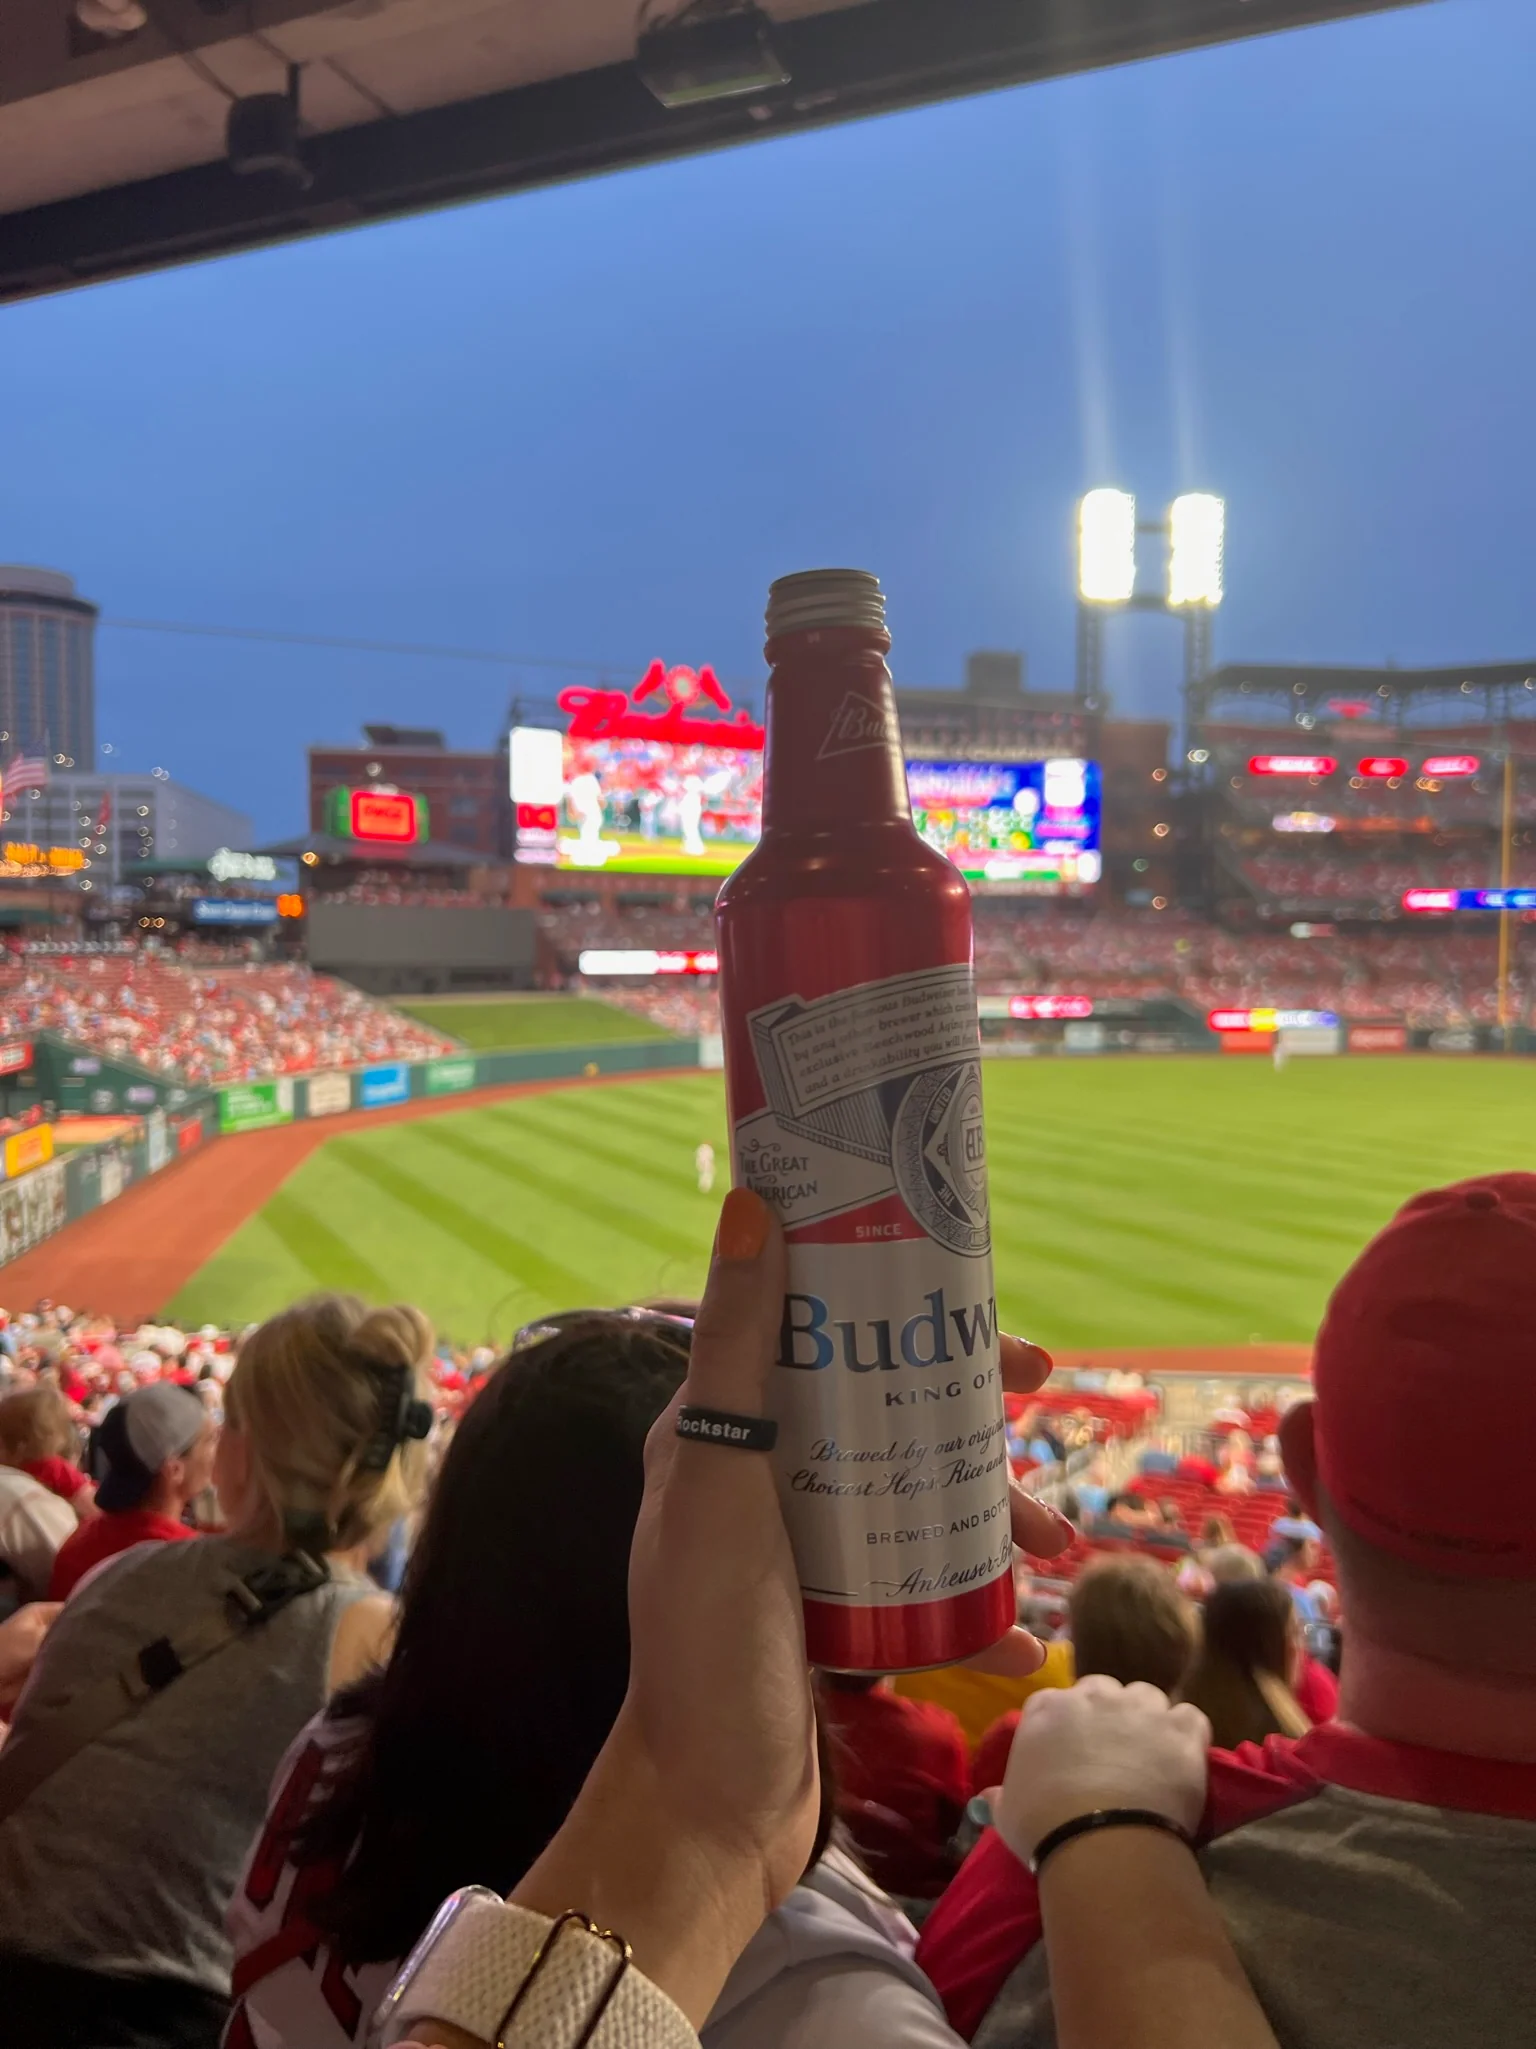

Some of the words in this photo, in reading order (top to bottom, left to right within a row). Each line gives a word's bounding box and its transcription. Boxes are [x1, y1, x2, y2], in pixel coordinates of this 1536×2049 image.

[788, 1028, 812, 1046] This
[815, 1023, 825, 1035] is
[829, 1014, 848, 1030] the
[902, 987, 955, 1008] Budweiser
[793, 1047, 809, 1062] by
[813, 1037, 836, 1054] any
[879, 1011, 921, 1031] brewer
[925, 1002, 953, 1018] which
[800, 1048, 858, 1076] exclusive
[863, 1023, 935, 1053] Beechwood
[805, 1075, 828, 1094] and
[832, 1070, 840, 1083] a
[844, 1046, 920, 1079] drinkability
[923, 1041, 942, 1056] you
[945, 1035, 961, 1049] will
[928, 1086, 952, 1125] UNITED
[759, 1151, 810, 1176] GREAT
[855, 1223, 902, 1238] SINCE
[776, 1287, 999, 1373] Budw
[885, 1381, 962, 1407] KING
[973, 1367, 994, 1389] OF
[810, 1438, 897, 1463] Brewed
[900, 1438, 928, 1471] by
[934, 1435, 965, 1453] our
[787, 1468, 878, 1497] Choicest
[932, 1458, 984, 1489] Rice
[866, 1523, 944, 1545] BREWED
[949, 1515, 980, 1535] AND
